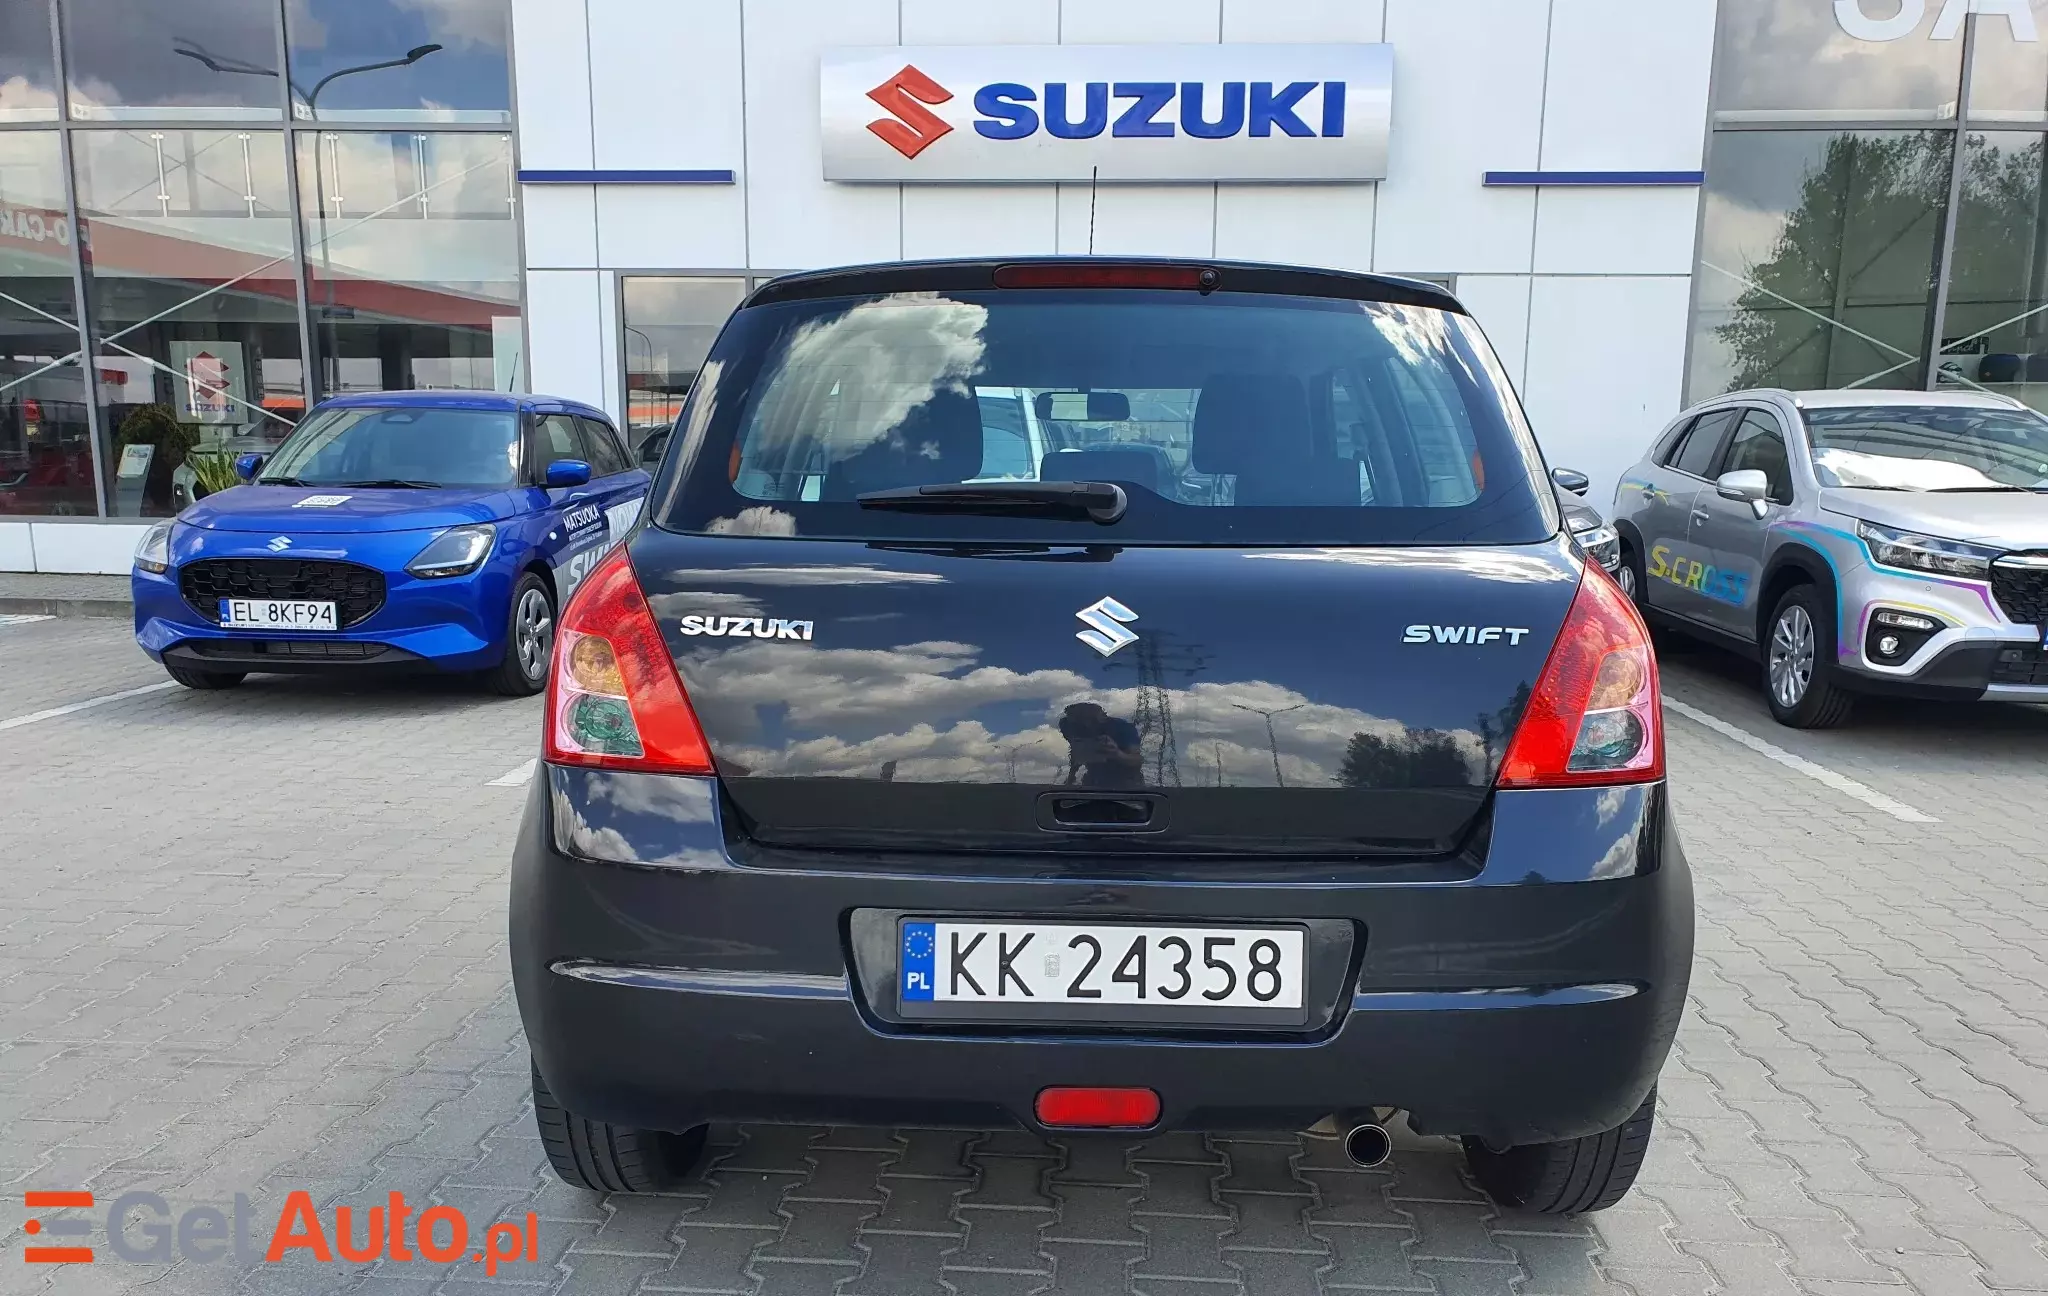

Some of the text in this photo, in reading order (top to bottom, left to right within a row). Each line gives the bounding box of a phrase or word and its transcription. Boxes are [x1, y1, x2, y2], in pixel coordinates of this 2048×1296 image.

[973, 81, 1346, 140] SUZUKI
[563, 504, 600, 532] MATSUOKA
[233, 602, 332, 624] EL 8KF94
[680, 615, 814, 641] SUZUKI
[1403, 625, 1530, 646] SWIFT
[950, 931, 1282, 1002] KK 24358
[906, 971, 931, 991] PL
